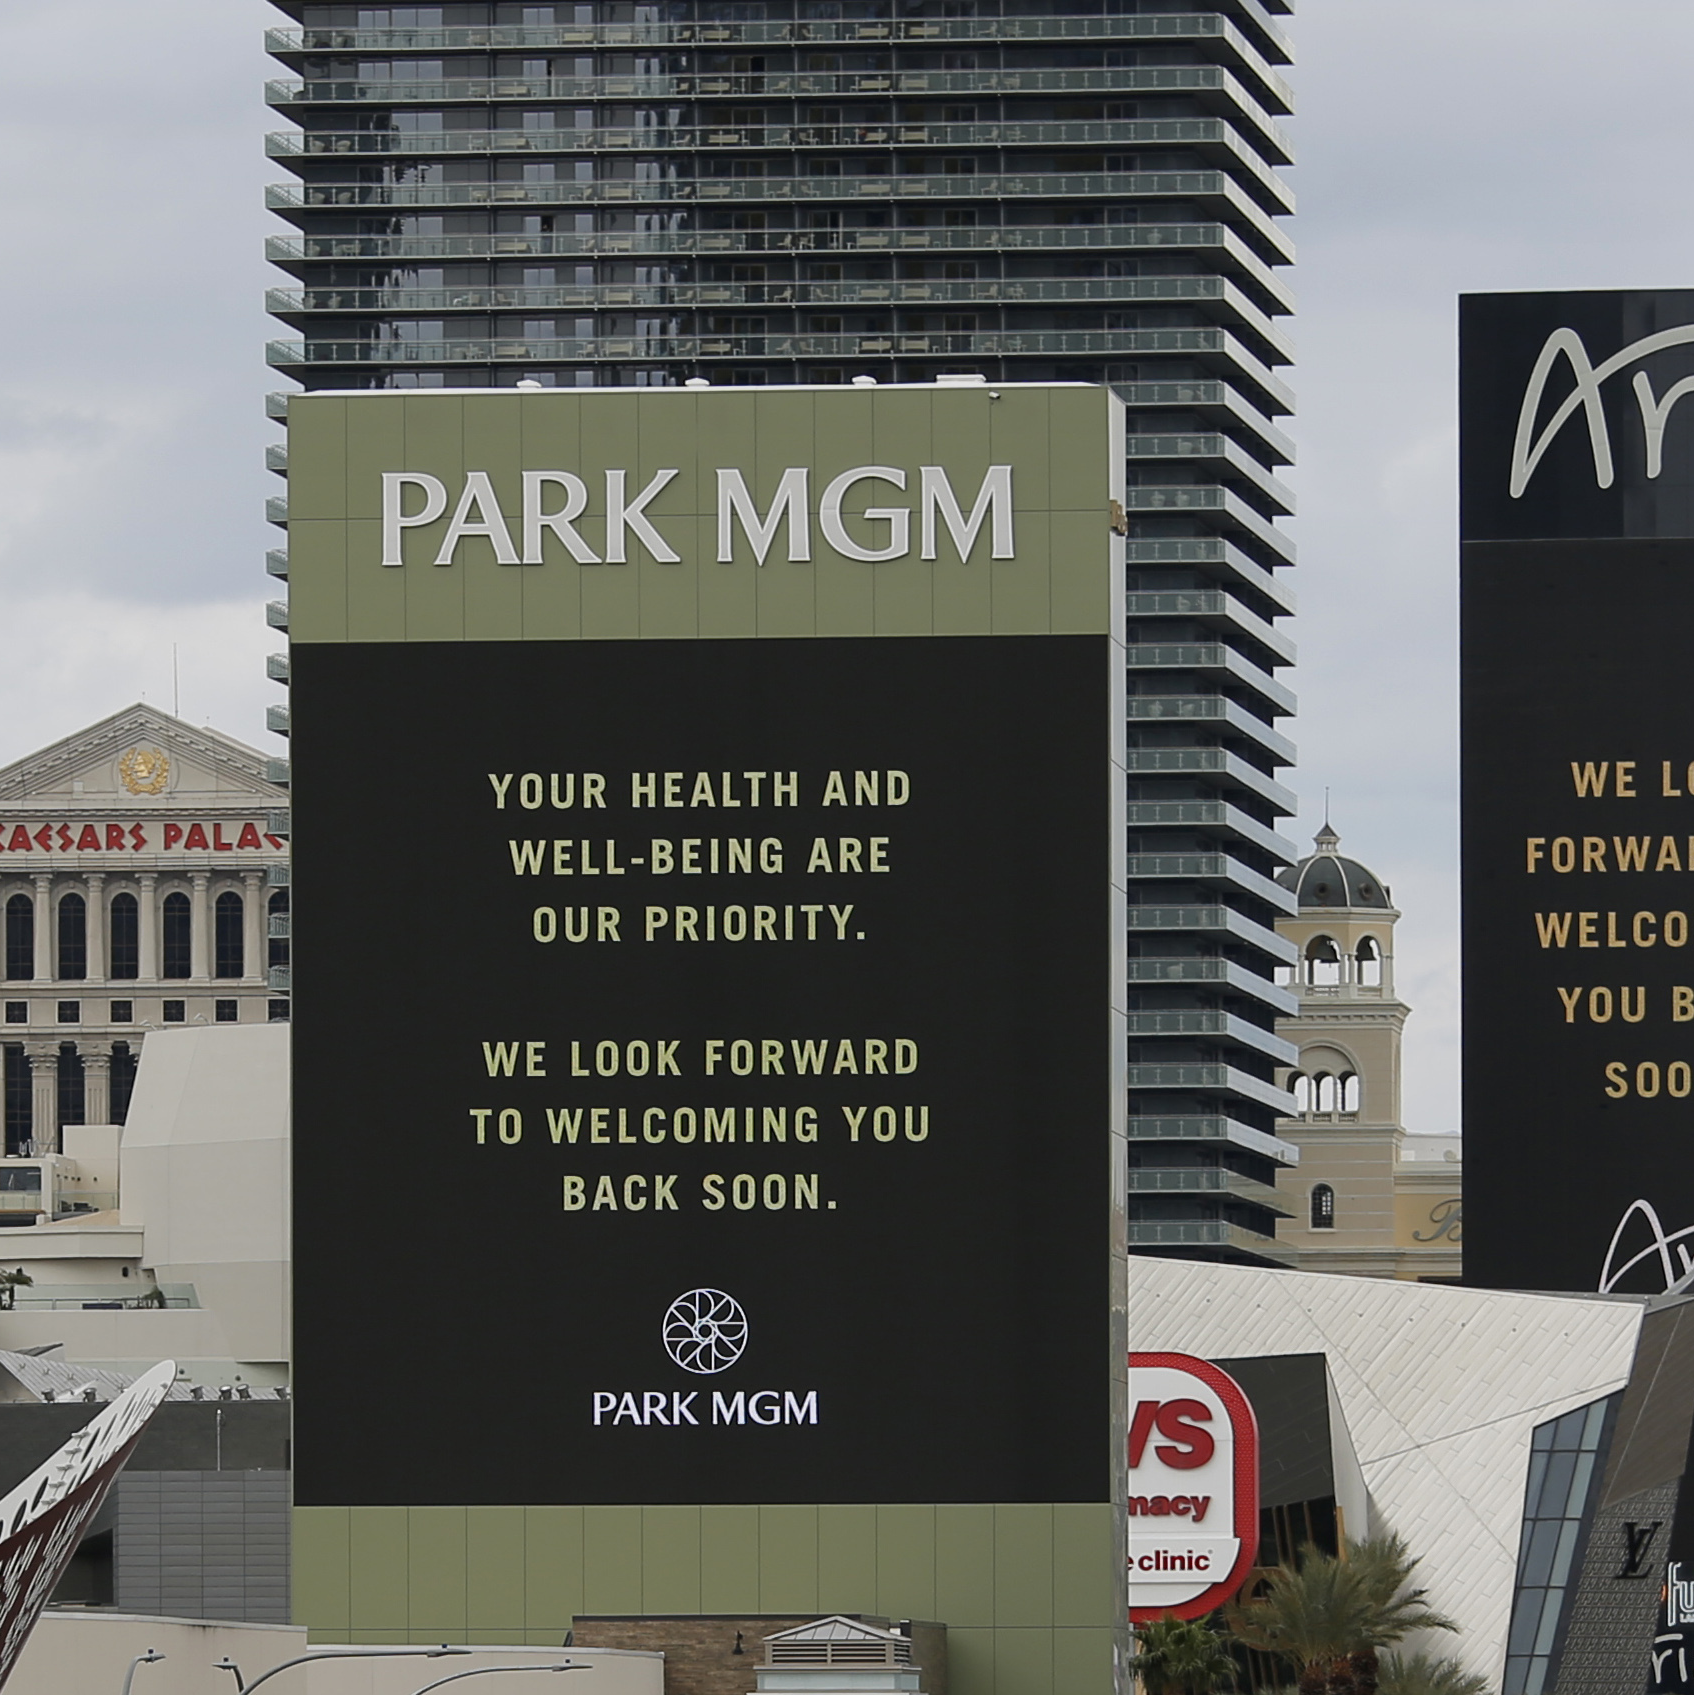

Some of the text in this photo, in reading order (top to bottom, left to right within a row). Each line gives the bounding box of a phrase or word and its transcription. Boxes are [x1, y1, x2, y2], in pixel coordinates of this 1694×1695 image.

[380, 464, 1016, 568] PARK MGM
[487, 768, 911, 811] YOUR HEALTH AND
[1570, 760, 1637, 799] WE
[508, 835, 891, 877] WELL-BEING ARE
[532, 903, 867, 944] OUR PRIORITY.
[1556, 985, 1647, 1025] YOU
[481, 1037, 919, 1078] WE LOOK FORWARD
[468, 1104, 930, 1146] TO WELCOMING YOU
[562, 1172, 840, 1212] BACK SOON.
[592, 1389, 819, 1427] PARK MGM
[1128, 1397, 1215, 1470] VS
[1128, 1494, 1211, 1522] macy
[1138, 1549, 1210, 1571] clinic
